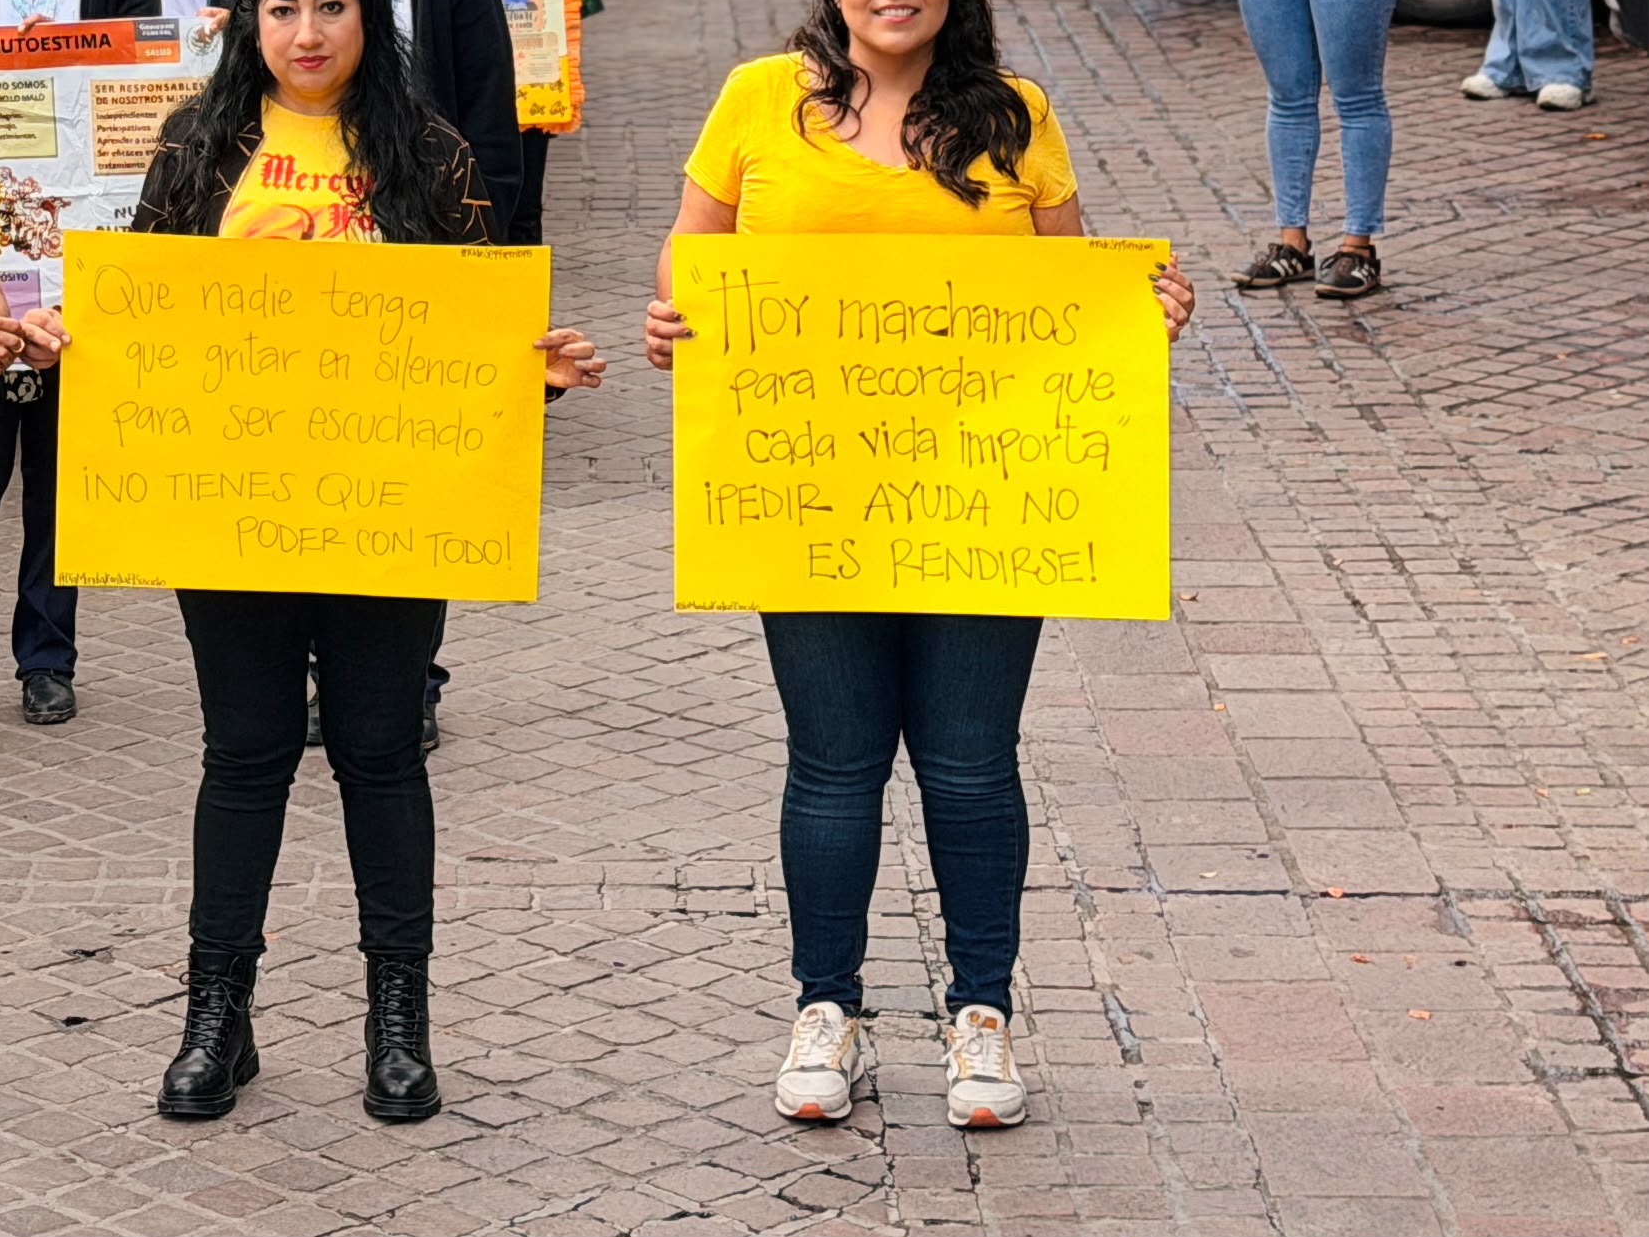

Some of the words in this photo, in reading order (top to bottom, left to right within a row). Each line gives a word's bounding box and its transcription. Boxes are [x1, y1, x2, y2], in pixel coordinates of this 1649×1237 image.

[144, 48, 173, 57] SALUD
[95, 84, 115, 94] SER
[96, 96, 109, 106] DE
[111, 95, 164, 105] NOSOTROS
[201, 273, 296, 318] nadie
[320, 271, 429, 344] tenga
[838, 280, 1080, 347] marchamos
[125, 339, 178, 389] que
[203, 331, 301, 394] gritar
[319, 350, 351, 380] en
[375, 336, 498, 389] silencio
[729, 366, 816, 416] para
[840, 356, 1015, 407] recordar
[1043, 367, 1115, 429] que
[112, 401, 191, 448] para
[223, 404, 286, 441] ser
[745, 420, 836, 468] cada
[858, 415, 938, 463] vida
[166, 472, 296, 502] TIENES
[316, 473, 410, 510] QUE
[704, 481, 833, 527] ¡PEDIR
[863, 481, 991, 527] AYUDA
[1022, 487, 1079, 525] NO
[236, 515, 346, 558] PODER
[356, 527, 413, 556] CON
[424, 531, 512, 571] TODO!
[808, 539, 861, 581] ES
[890, 539, 1097, 589] RENDIRSE!
